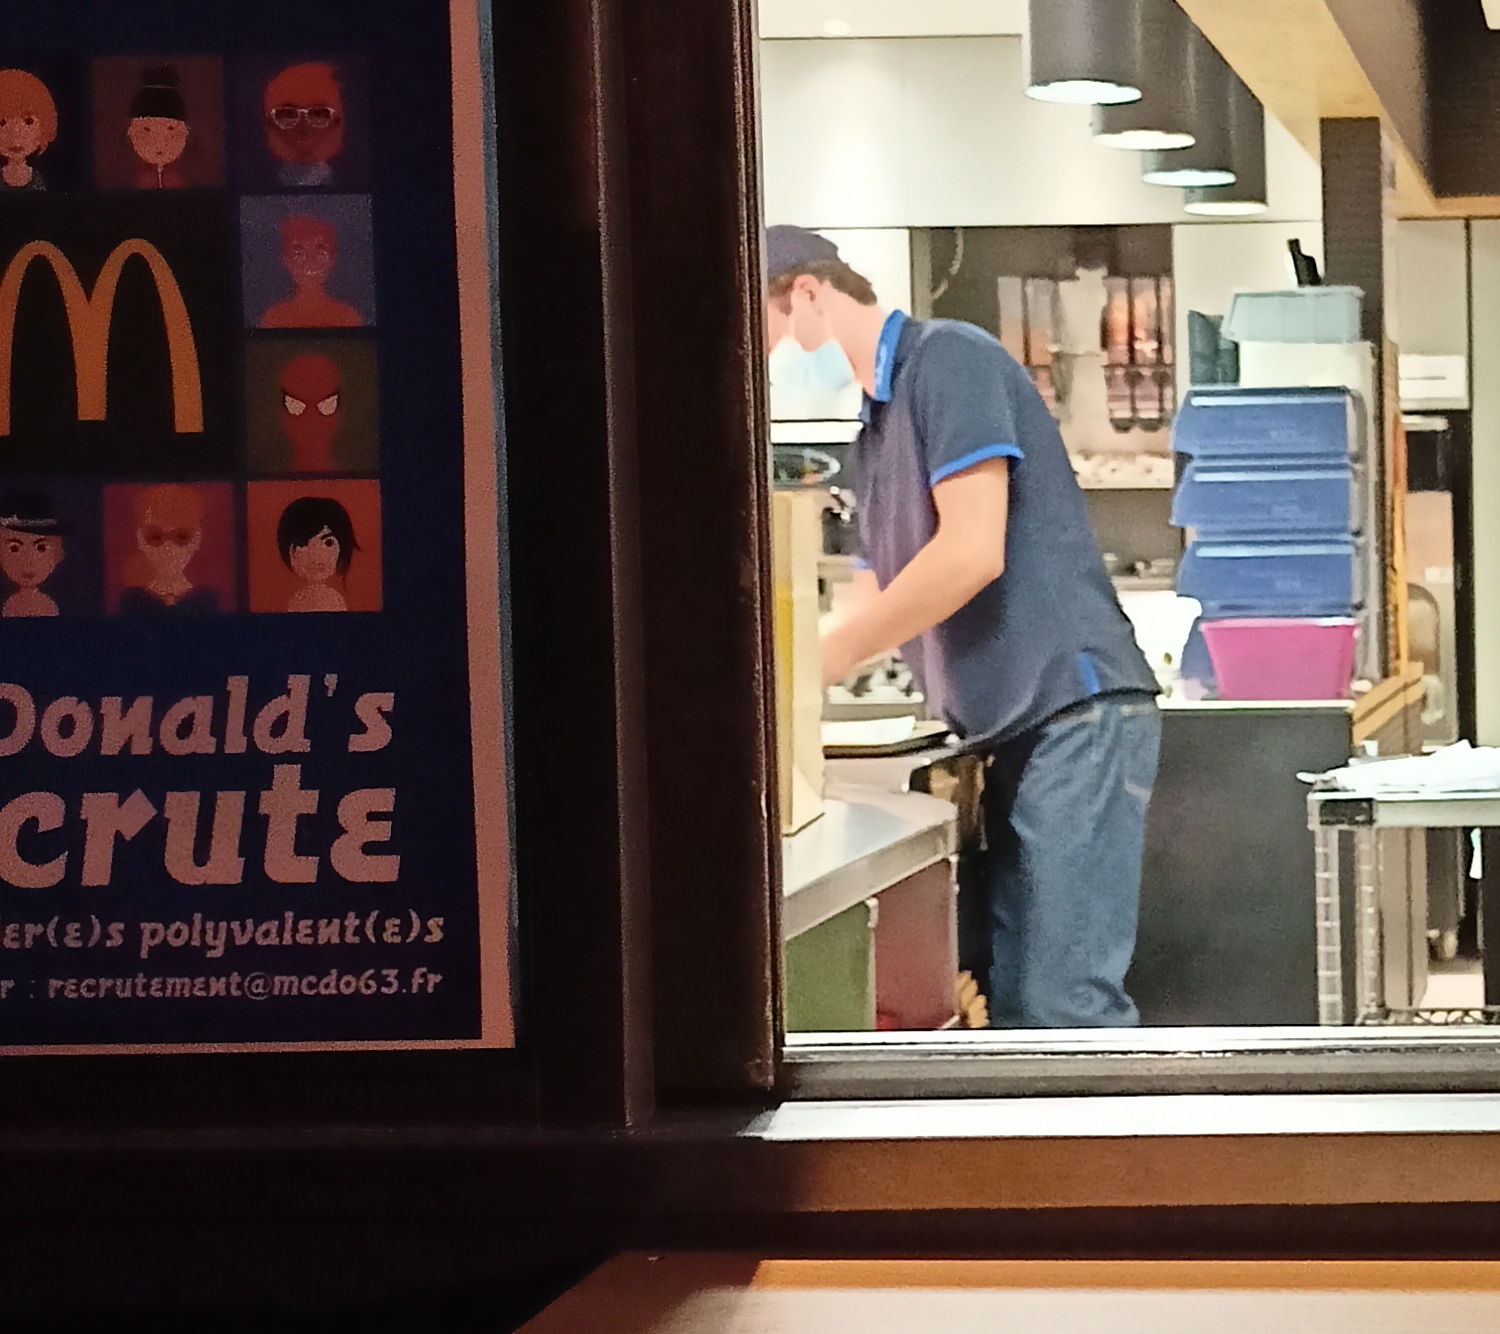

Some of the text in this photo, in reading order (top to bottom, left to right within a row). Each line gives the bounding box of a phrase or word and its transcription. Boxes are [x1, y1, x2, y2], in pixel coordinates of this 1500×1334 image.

[0, 763, 401, 889] crute
[140, 908, 445, 959] polyvalent(e)s
[47, 967, 443, 1000] recrutement@mcdo63.fr
